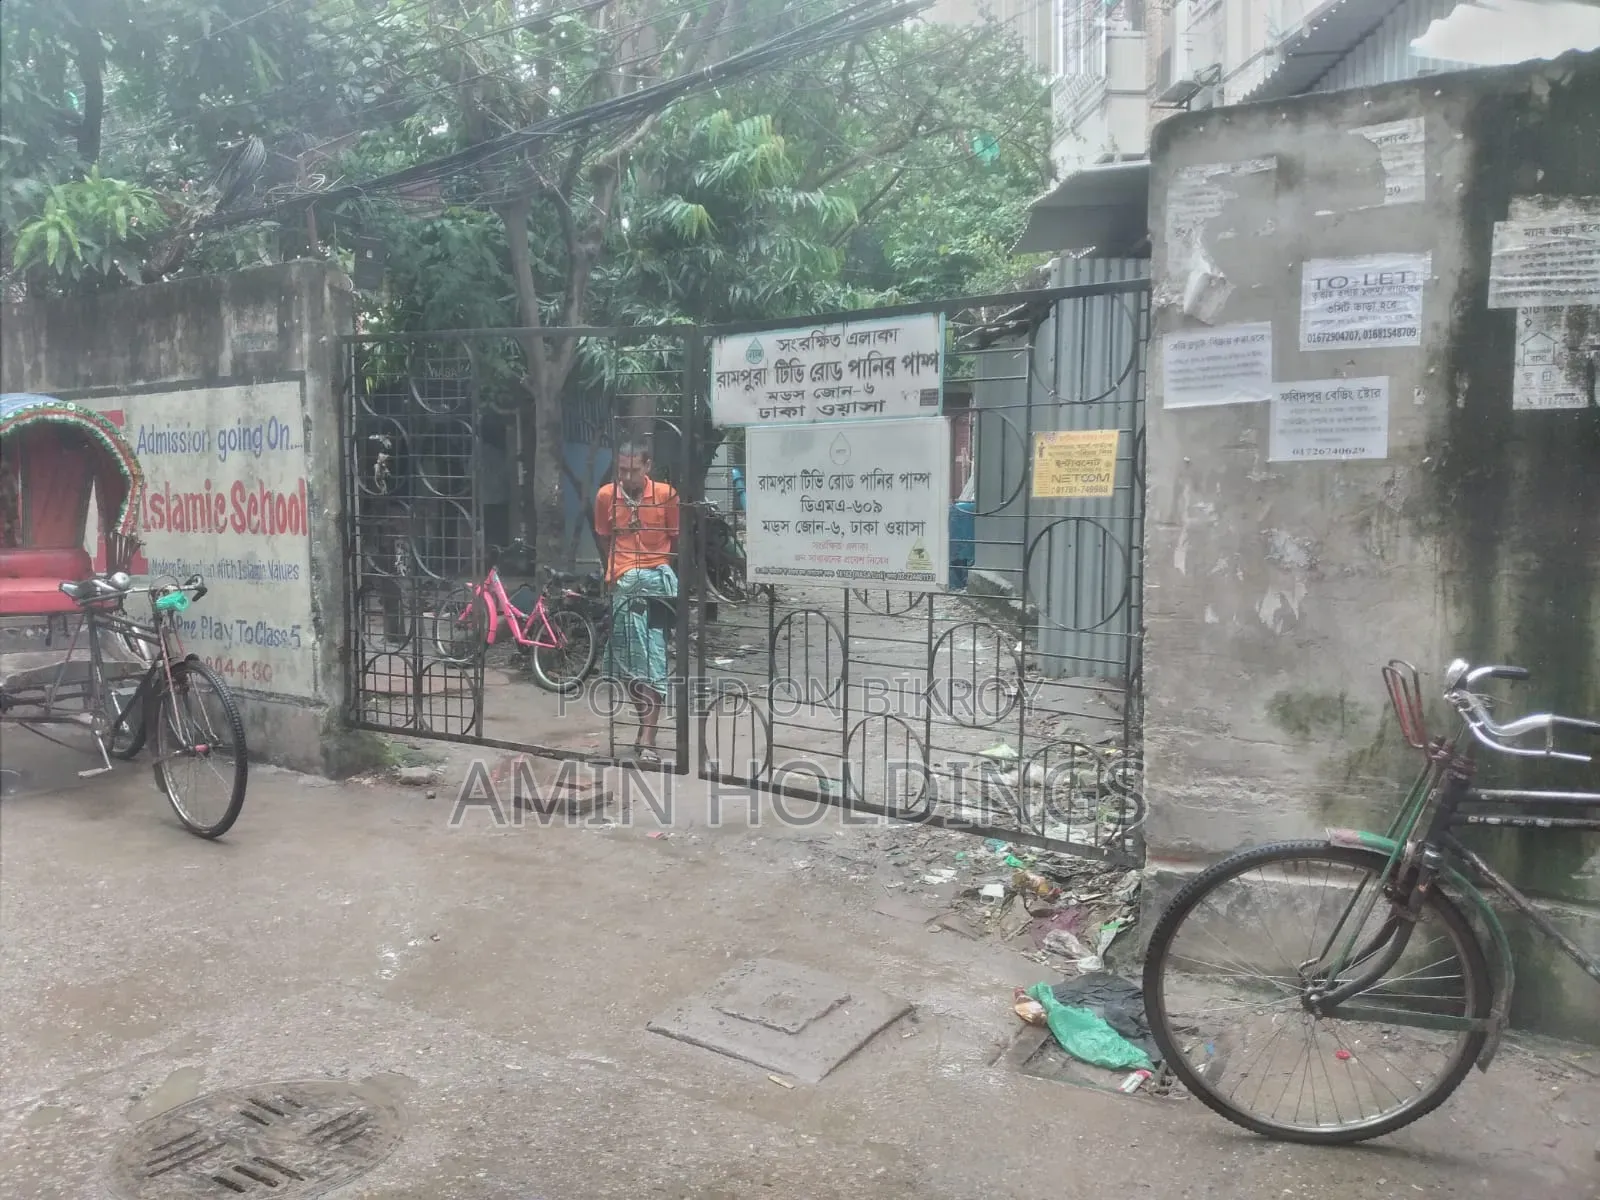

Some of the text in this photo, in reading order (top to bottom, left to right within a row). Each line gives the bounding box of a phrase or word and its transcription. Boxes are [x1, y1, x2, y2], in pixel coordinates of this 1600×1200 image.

[776, 329, 840, 354] সংরক্ষিত
[846, 327, 902, 347] এলাকা
[715, 349, 940, 392] রামপুরা টিভি রোড পানির পাম্প
[758, 399, 886, 419] ঢাকা ওয়াসা
[136, 423, 211, 455] Admission
[218, 417, 264, 462] going
[757, 467, 932, 495] রামপুরা টিভি রোড পানির পাম্প
[141, 477, 308, 536] Islamic School
[850, 520, 880, 536] ঢাকা
[885, 520, 927, 536] ওয়াসা
[268, 560, 300, 581] Values
[201, 615, 233, 650] Play
[236, 620, 254, 644] To
[290, 625, 302, 650] 5
